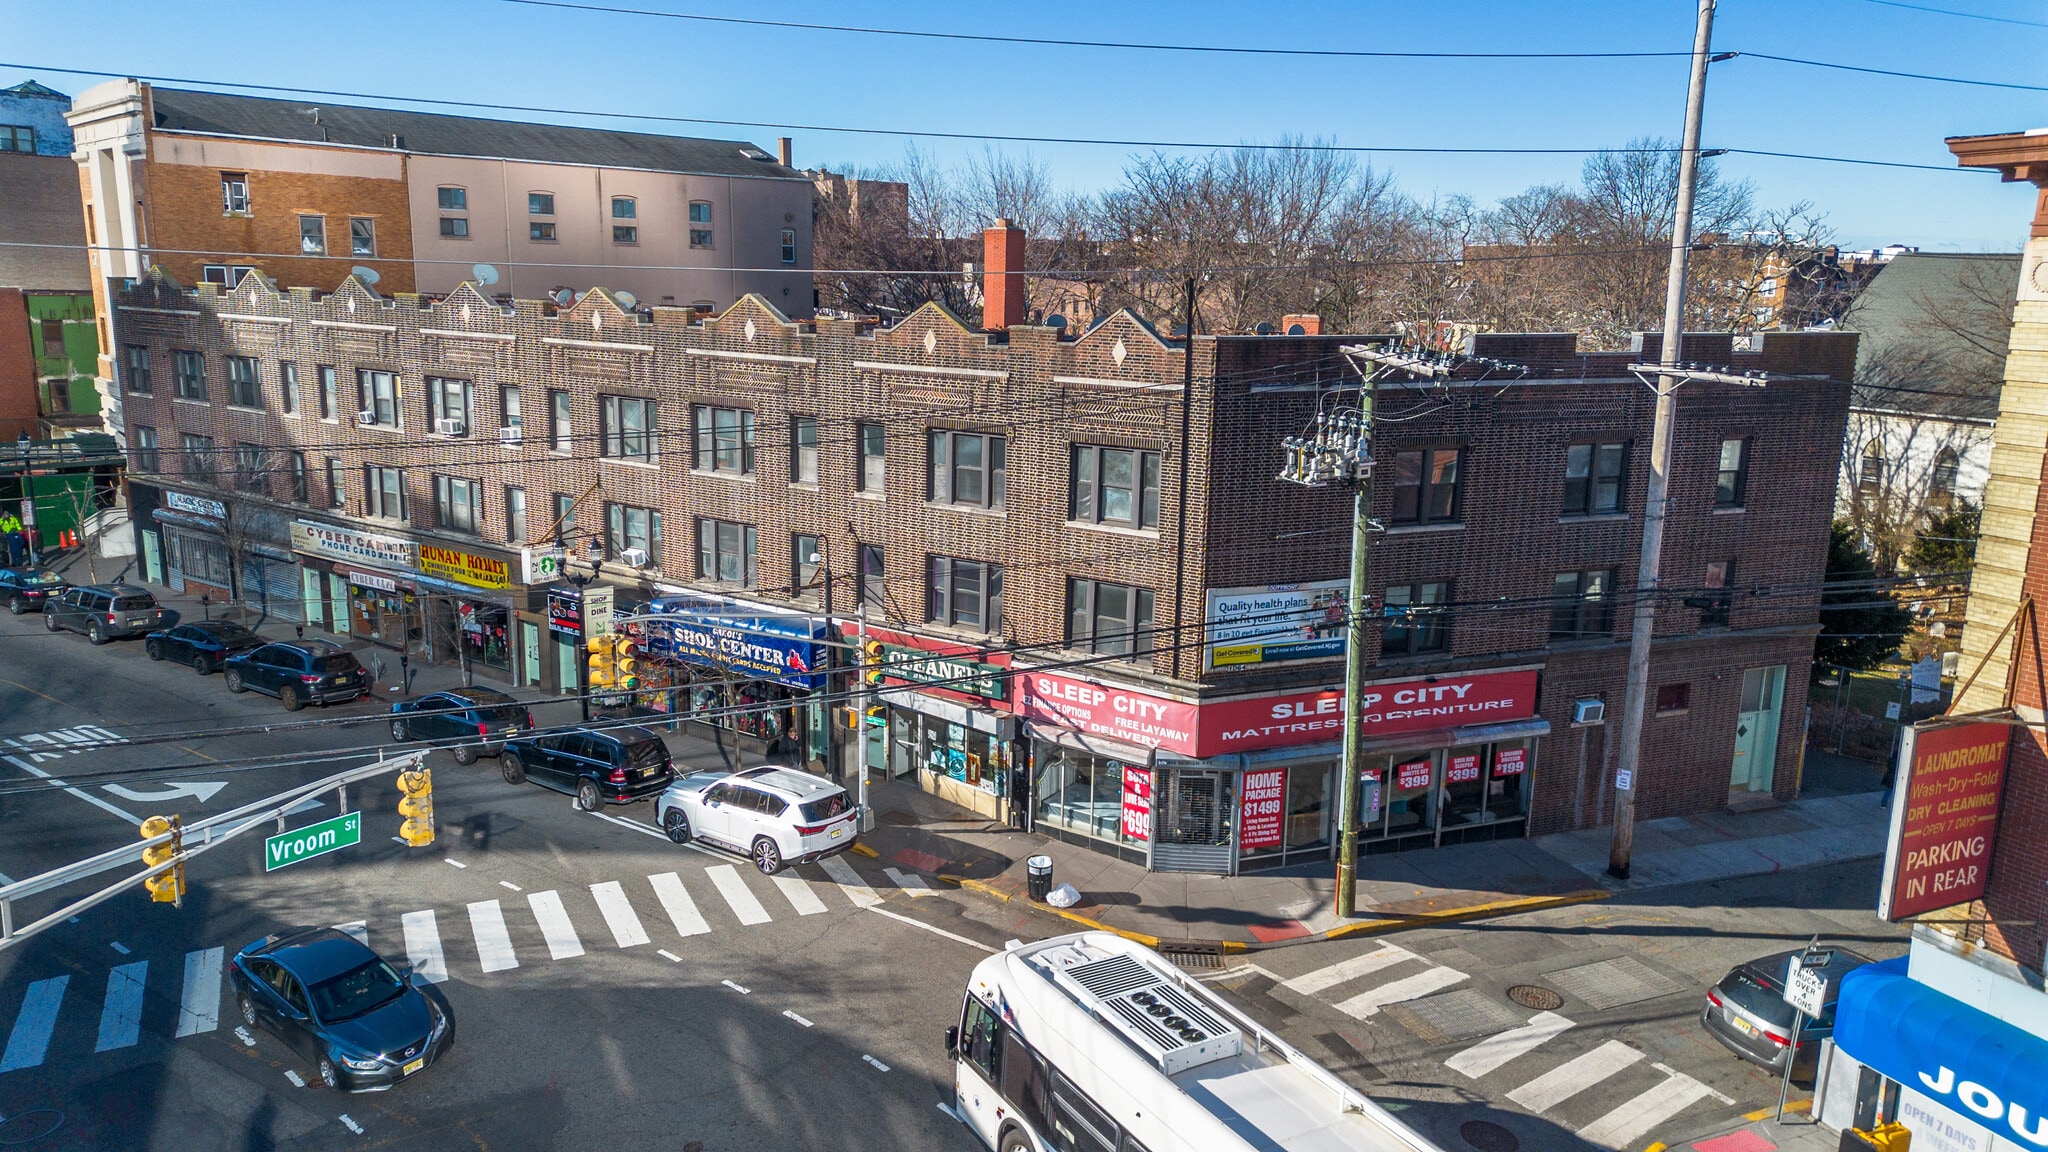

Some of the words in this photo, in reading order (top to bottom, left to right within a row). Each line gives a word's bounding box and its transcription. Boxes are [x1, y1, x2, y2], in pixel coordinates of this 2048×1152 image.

[307, 527, 351, 545] CYBER
[322, 540, 350, 552] PHONE
[421, 545, 460, 565] HUNAN
[351, 573, 374, 586] CYBER
[591, 596, 607, 604] SHOP
[1219, 600, 1252, 613] Quality
[1254, 598, 1282, 609] health
[1284, 597, 1308, 609] plans
[591, 607, 607, 616] DINE
[674, 628, 716, 649] SHOE
[720, 638, 785, 666] CENTER
[1227, 648, 1252, 656] Covered
[889, 651, 993, 688] CLEANERS
[1033, 697, 1061, 713] FINANCE
[1062, 703, 1091, 720] OPTIONS
[1038, 678, 1106, 706] SLEEP
[1113, 695, 1168, 721] CITY
[1271, 693, 1383, 719] SLEP
[1393, 683, 1474, 705] CITY
[1052, 713, 1087, 729] FAST
[1091, 723, 1162, 748] DELIVERY
[1115, 716, 1139, 731] FREE
[1141, 721, 1189, 742] LAYAWAY
[1496, 761, 1524, 773] $199
[1915, 741, 2005, 776] LAUNDROMAT
[1127, 770, 1149, 784] SOFA
[1246, 771, 1282, 789] HOME
[1400, 774, 1429, 787] $399
[1448, 767, 1479, 780] $399
[1134, 783, 1142, 794] &
[1245, 787, 1281, 800] PACKAGE
[1912, 769, 1999, 800] Wash-Dry-Fold
[1244, 800, 1280, 817] $1499
[1908, 804, 1932, 822] DRY
[1937, 792, 1996, 816] CLEANING
[1123, 808, 1149, 837] $699
[1922, 822, 1944, 837] OPEN
[1948, 820, 1953, 831] 7
[1955, 814, 1977, 831] DAYS
[270, 829, 336, 862] Vroom
[344, 817, 356, 830] St
[1906, 836, 1985, 871] PARKING
[1906, 875, 1926, 899] IN
[1933, 865, 1978, 893] REAR
[1793, 969, 1822, 990] TRUCKS
[1801, 967, 1816, 977] NO
[1795, 981, 1816, 996] OVER
[1793, 995, 1813, 1011] TONS
[1904, 1102, 1934, 1128] OPEN
[1937, 1119, 1943, 1132] 7
[1945, 1124, 1977, 1151] DAYS
